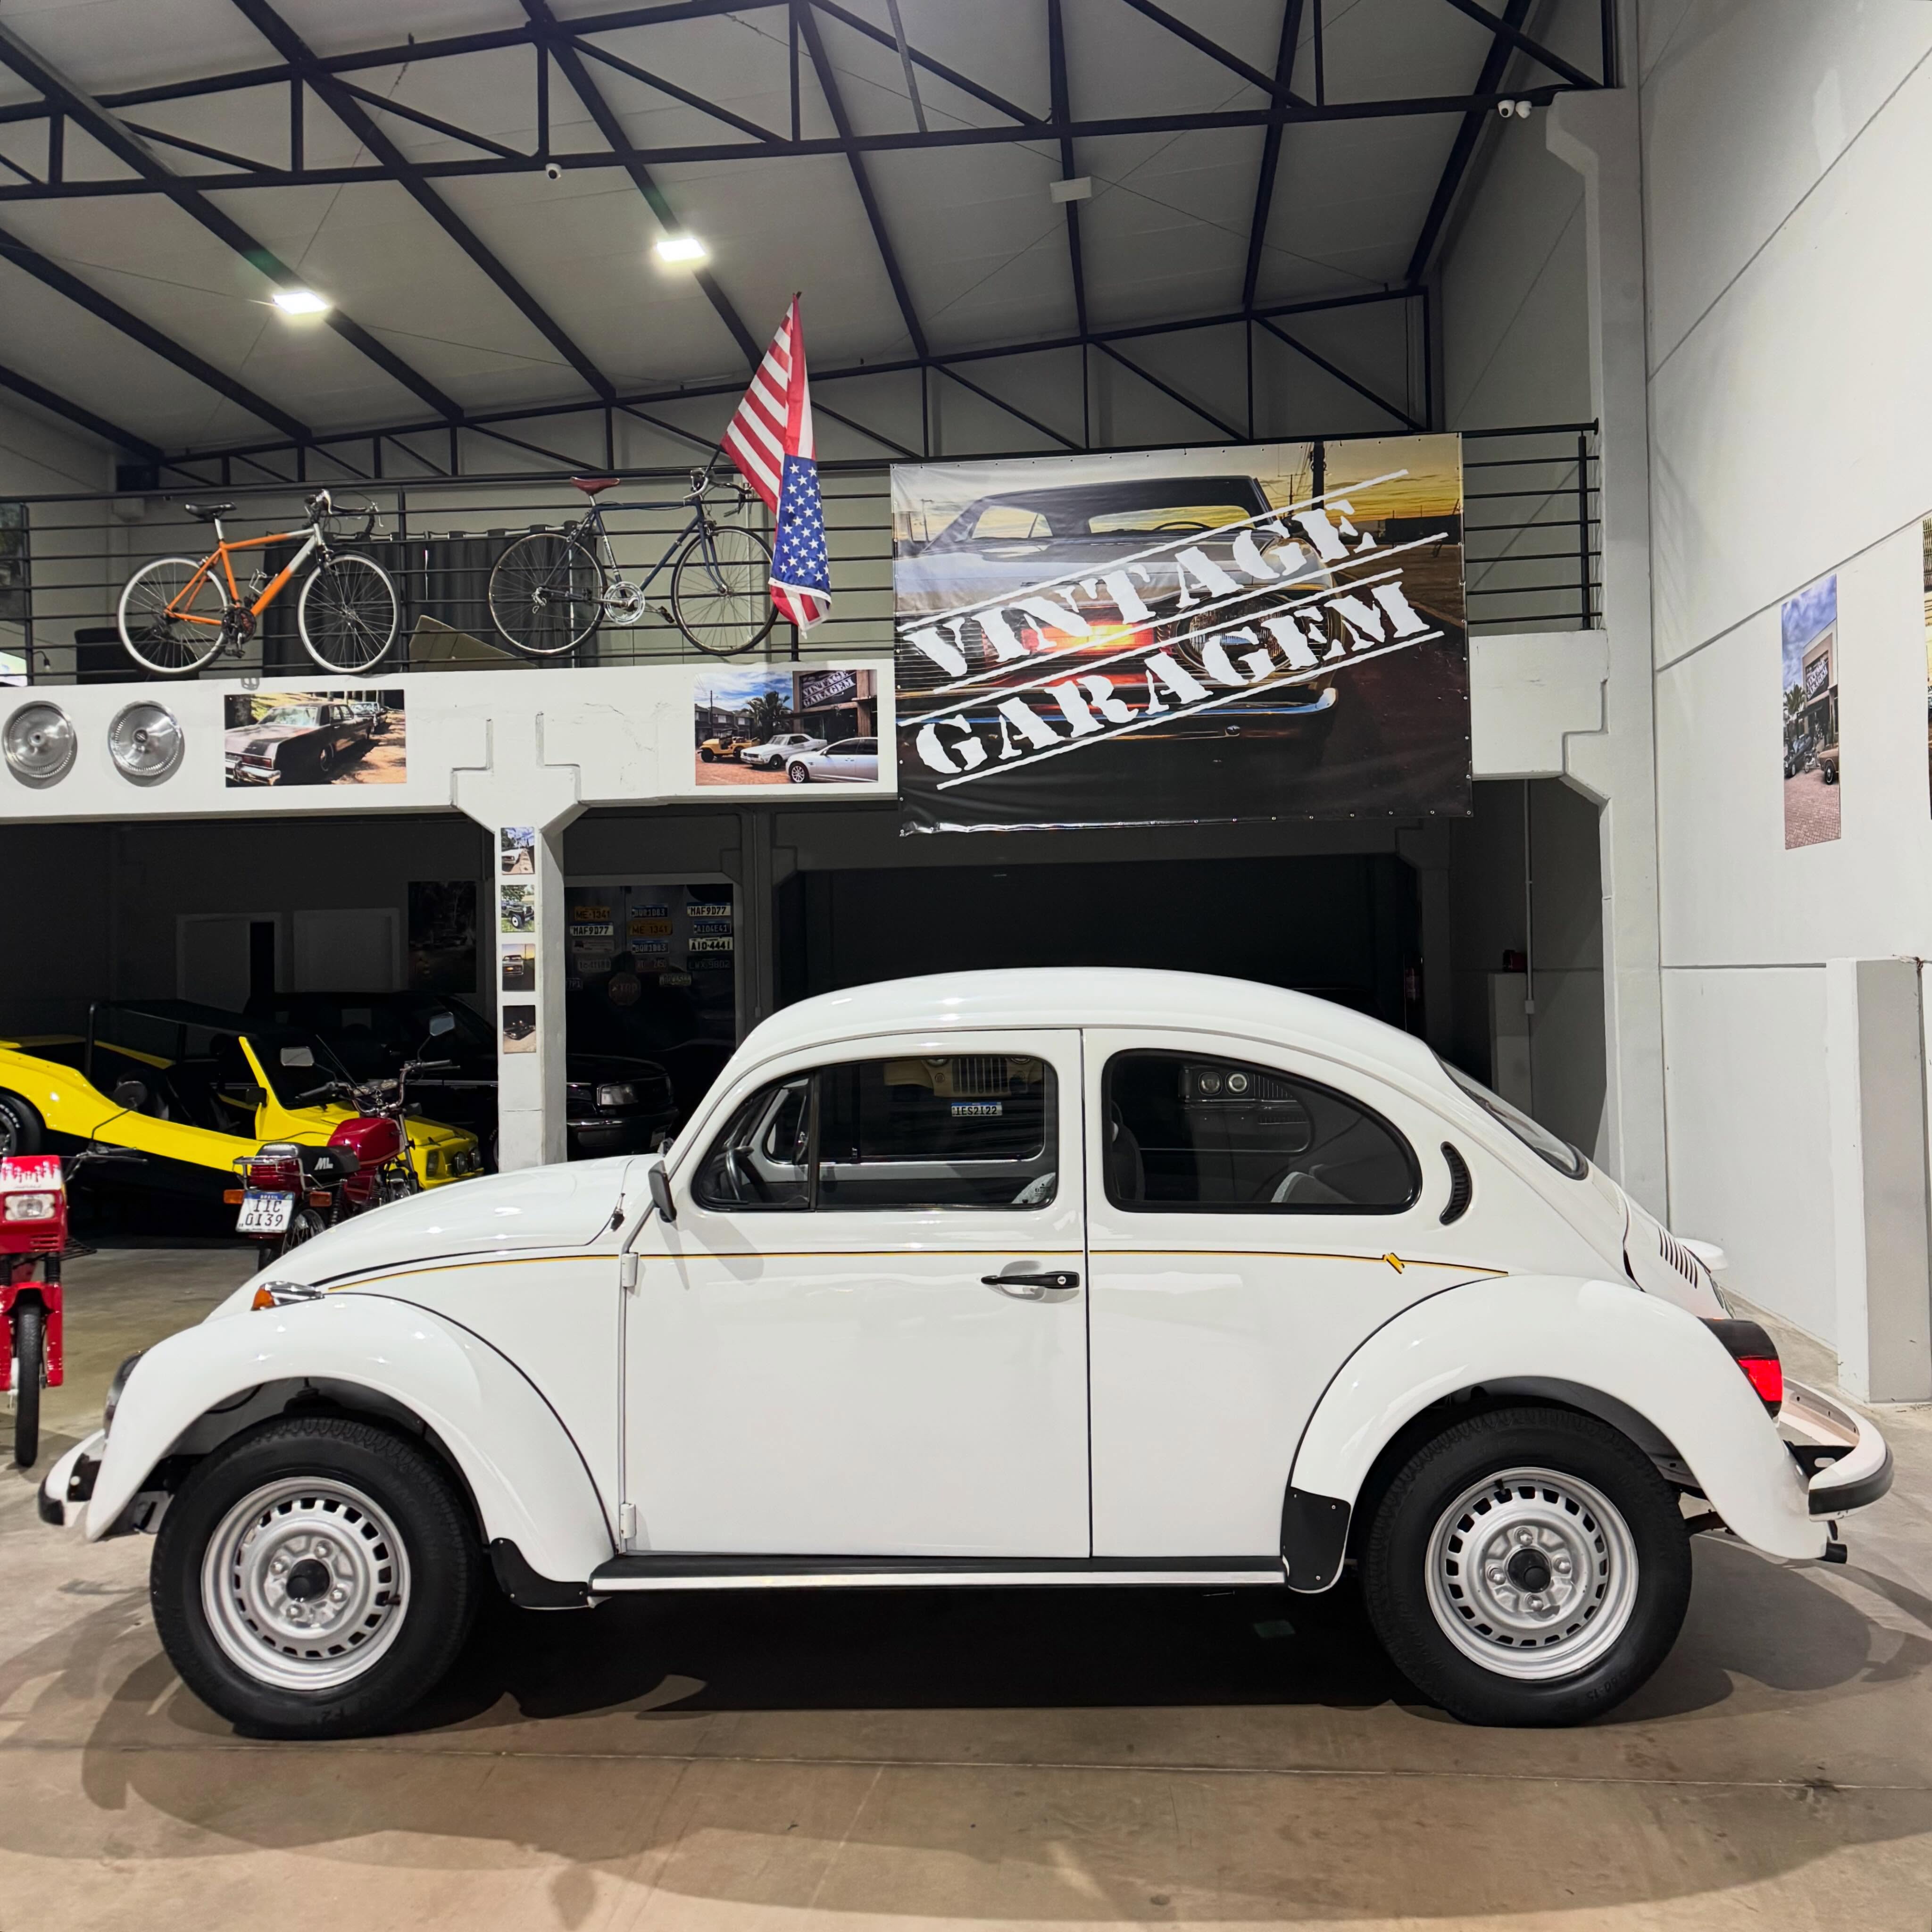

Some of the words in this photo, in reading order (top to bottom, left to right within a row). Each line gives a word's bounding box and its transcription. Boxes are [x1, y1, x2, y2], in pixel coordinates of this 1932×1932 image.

[903, 499, 1377, 677] VINTAGE
[803, 671, 849, 696] VINTAGE
[916, 581, 1431, 774] GARAGEM
[803, 677, 856, 706] GARAGEM
[691, 907, 726, 915] MAF9D77
[573, 926, 609, 935] MAF9D77
[314, 1157, 333, 1170] ML
[253, 1199, 282, 1213] IIC
